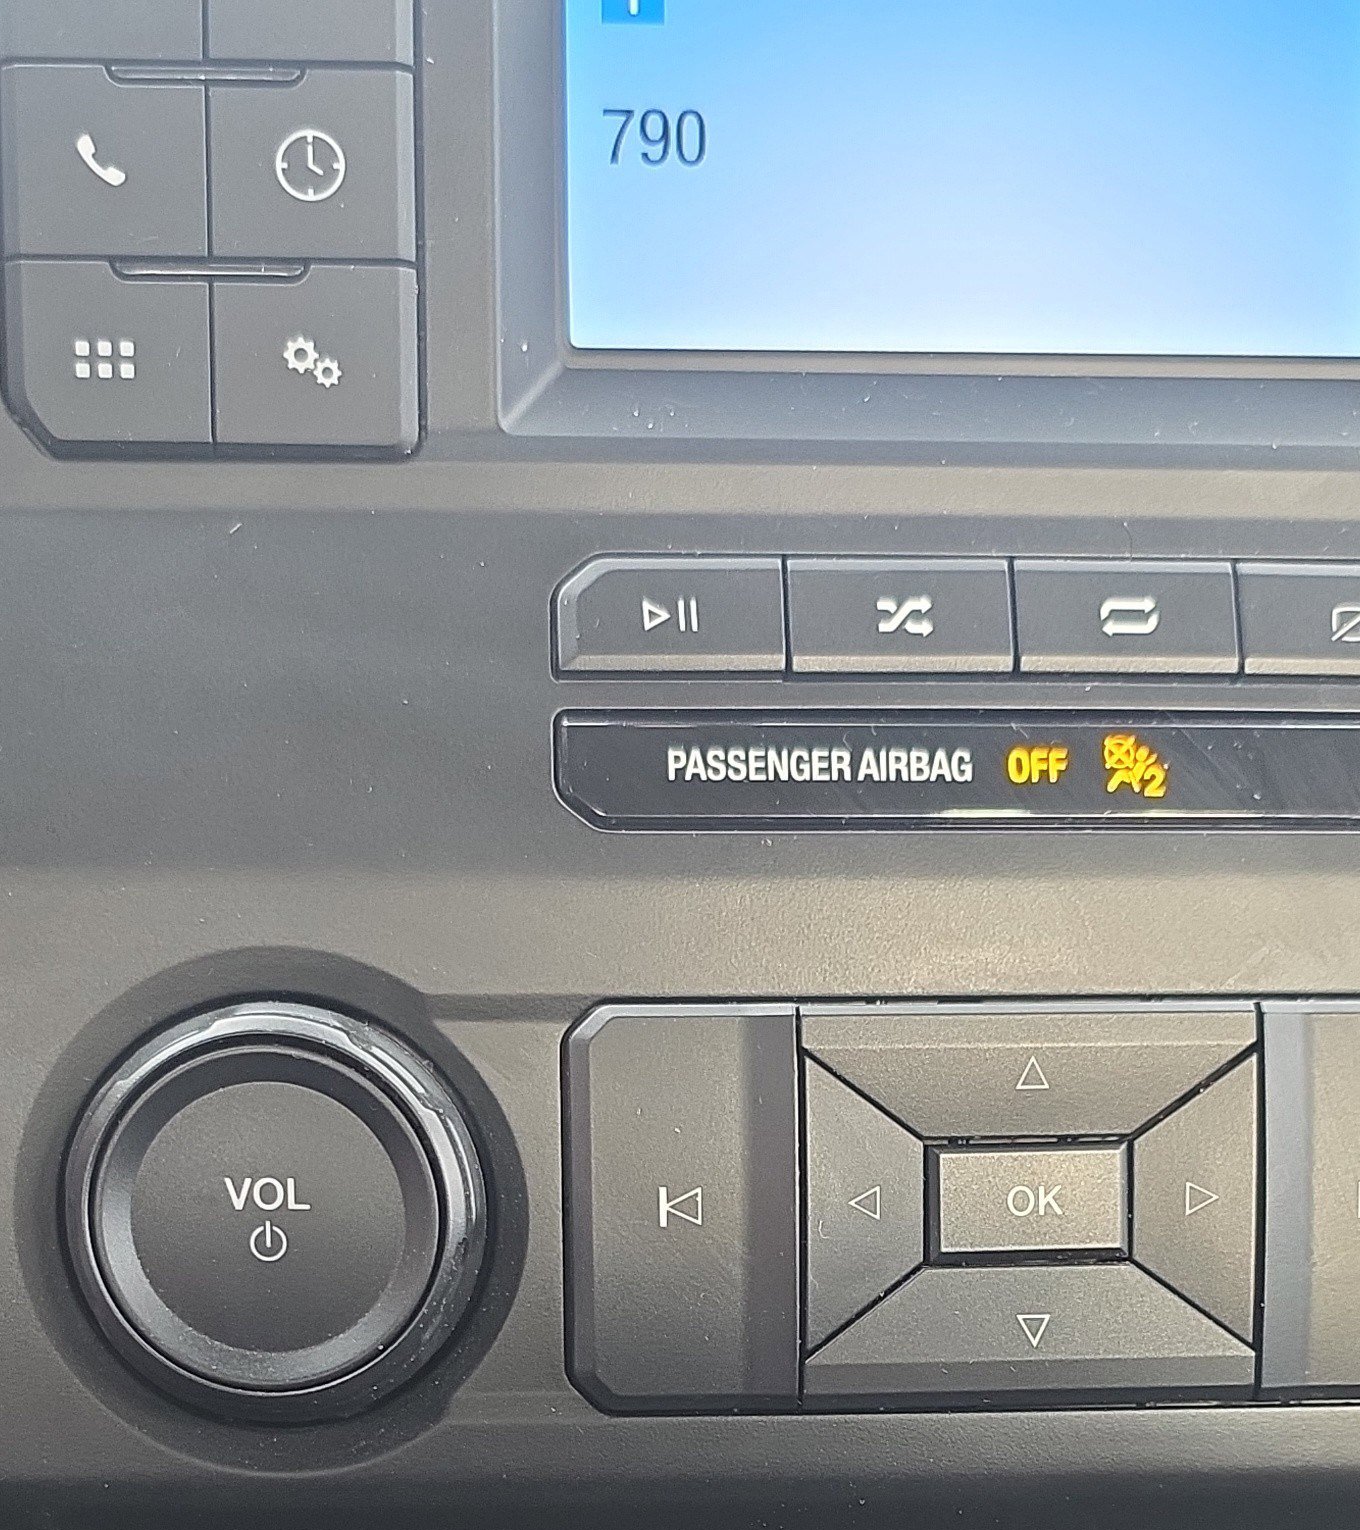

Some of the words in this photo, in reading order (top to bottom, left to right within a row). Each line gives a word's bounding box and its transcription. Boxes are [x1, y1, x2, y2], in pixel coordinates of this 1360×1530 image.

[601, 108, 707, 167] 790
[666, 749, 852, 784] PASSENGER
[857, 749, 974, 786] AIRBAG
[1007, 750, 1069, 785] OFF
[224, 1177, 311, 1211] VOL
[1005, 1184, 1063, 1219] OK
